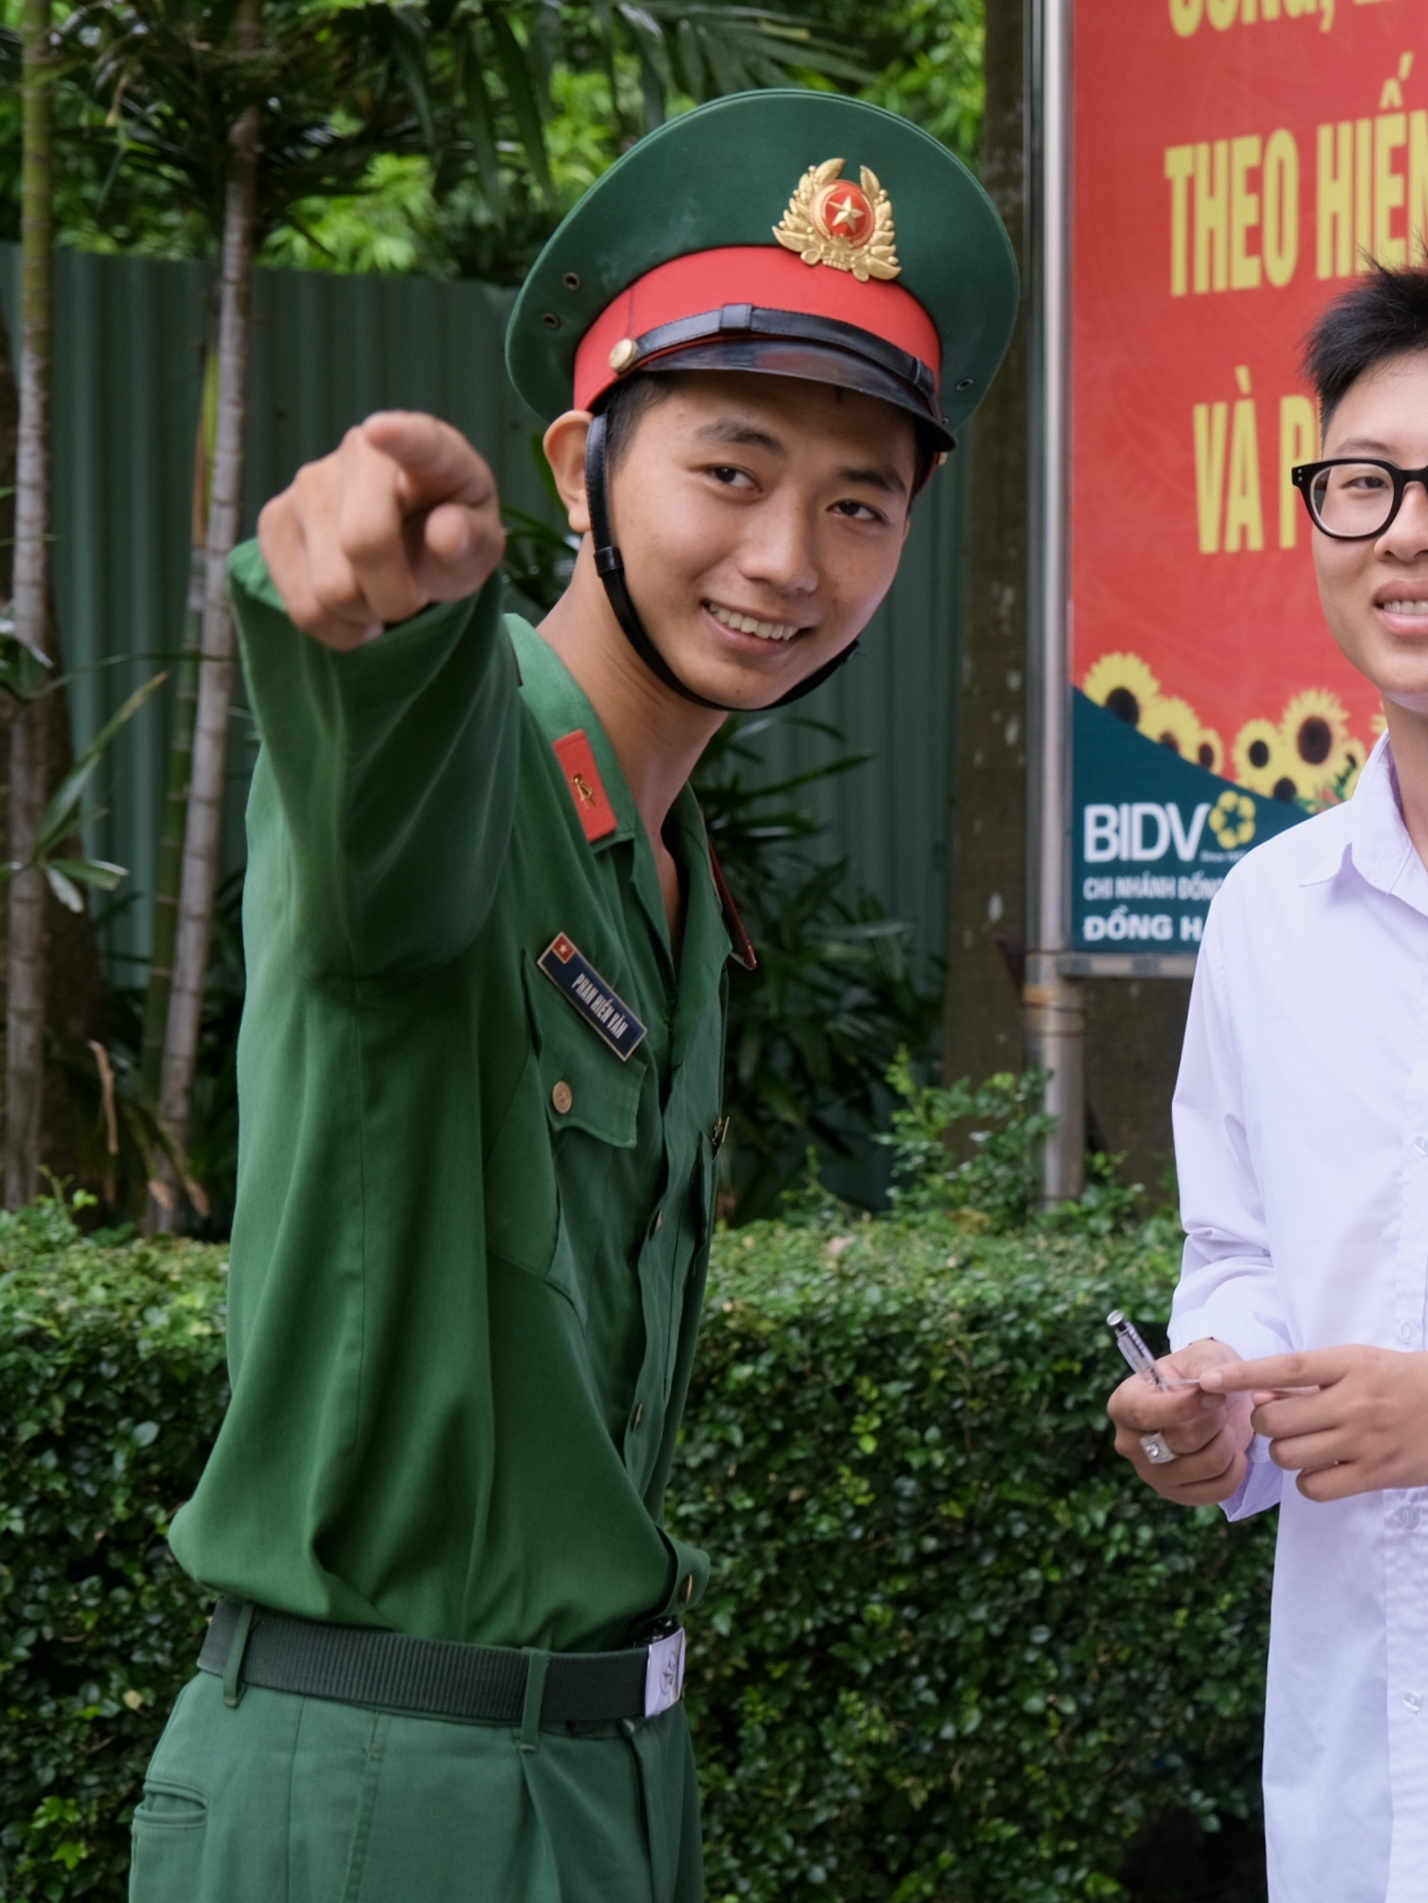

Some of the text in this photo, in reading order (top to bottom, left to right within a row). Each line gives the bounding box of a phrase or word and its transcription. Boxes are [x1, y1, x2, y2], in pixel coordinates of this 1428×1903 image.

[1164, 128, 1300, 297] THEO
[1193, 365, 1264, 555] VÀ
[1082, 876, 1114, 901] CHI
[1115, 869, 1177, 900] NHÁNH
[1083, 802, 1211, 863] BIDV
